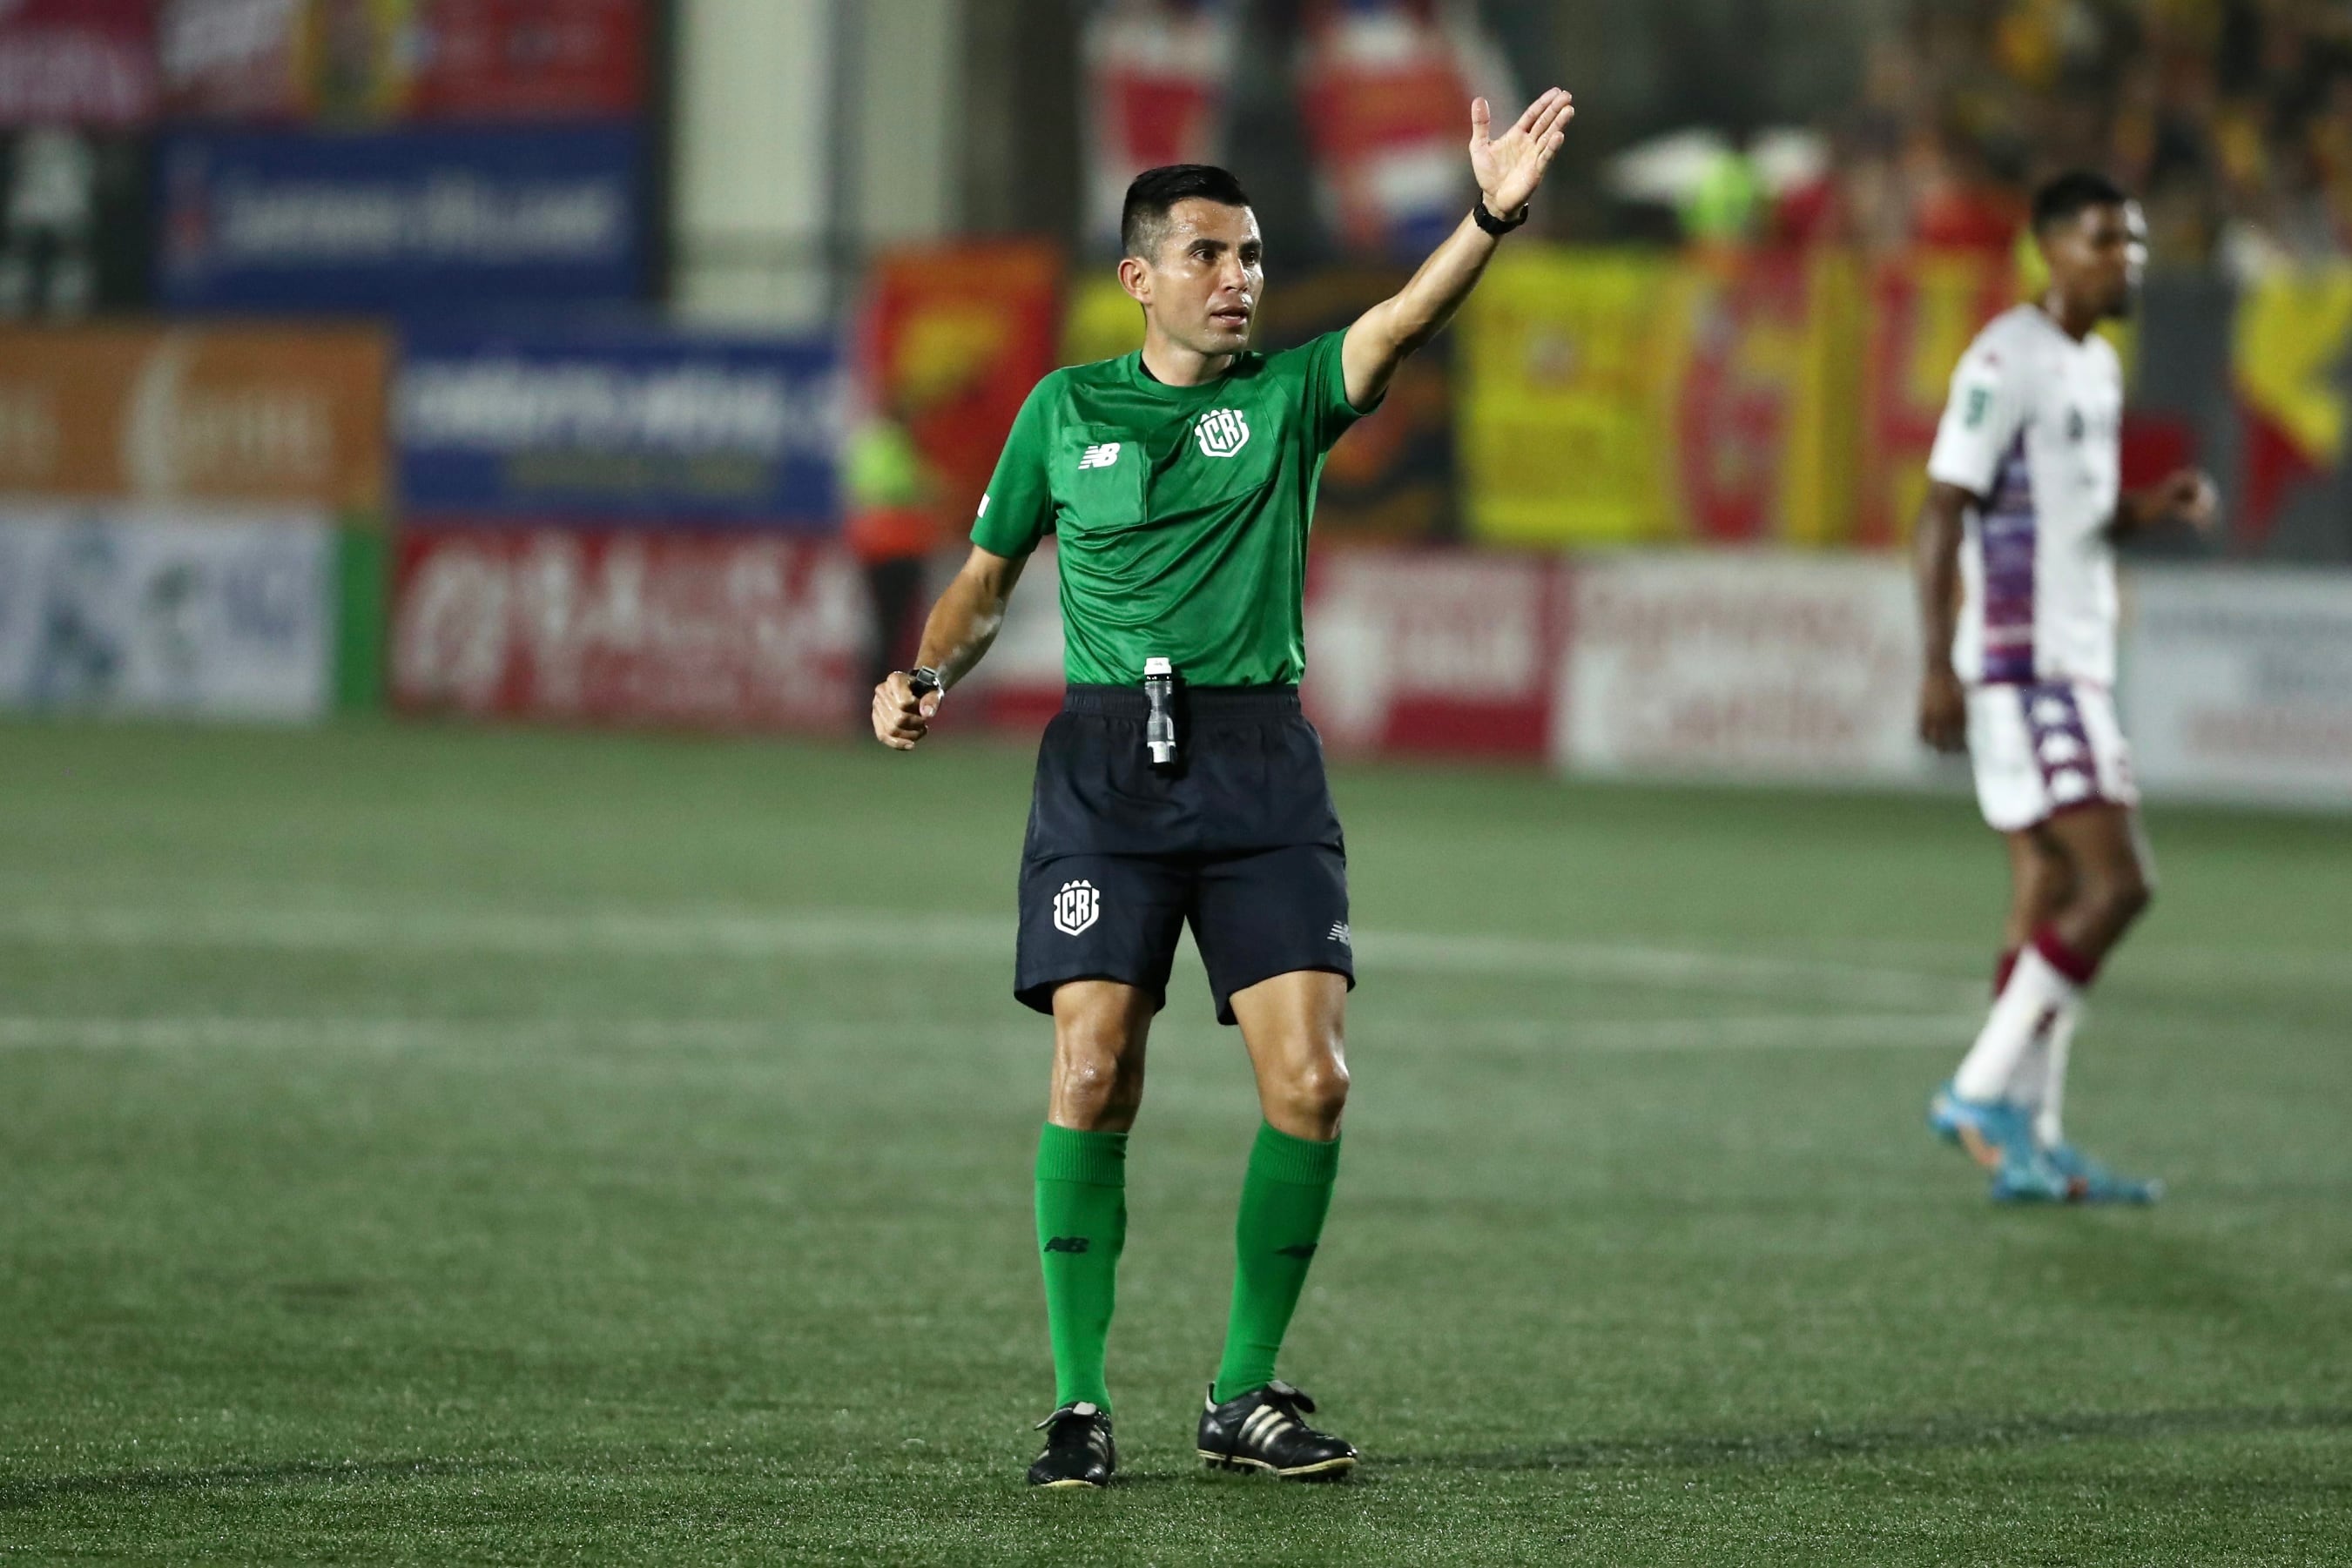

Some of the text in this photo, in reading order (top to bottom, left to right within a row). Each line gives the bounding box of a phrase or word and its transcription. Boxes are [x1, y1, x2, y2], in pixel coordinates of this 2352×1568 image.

[1203, 412, 1241, 450] CR
[1078, 442, 1121, 469] NB
[1062, 889, 1090, 928] CR
